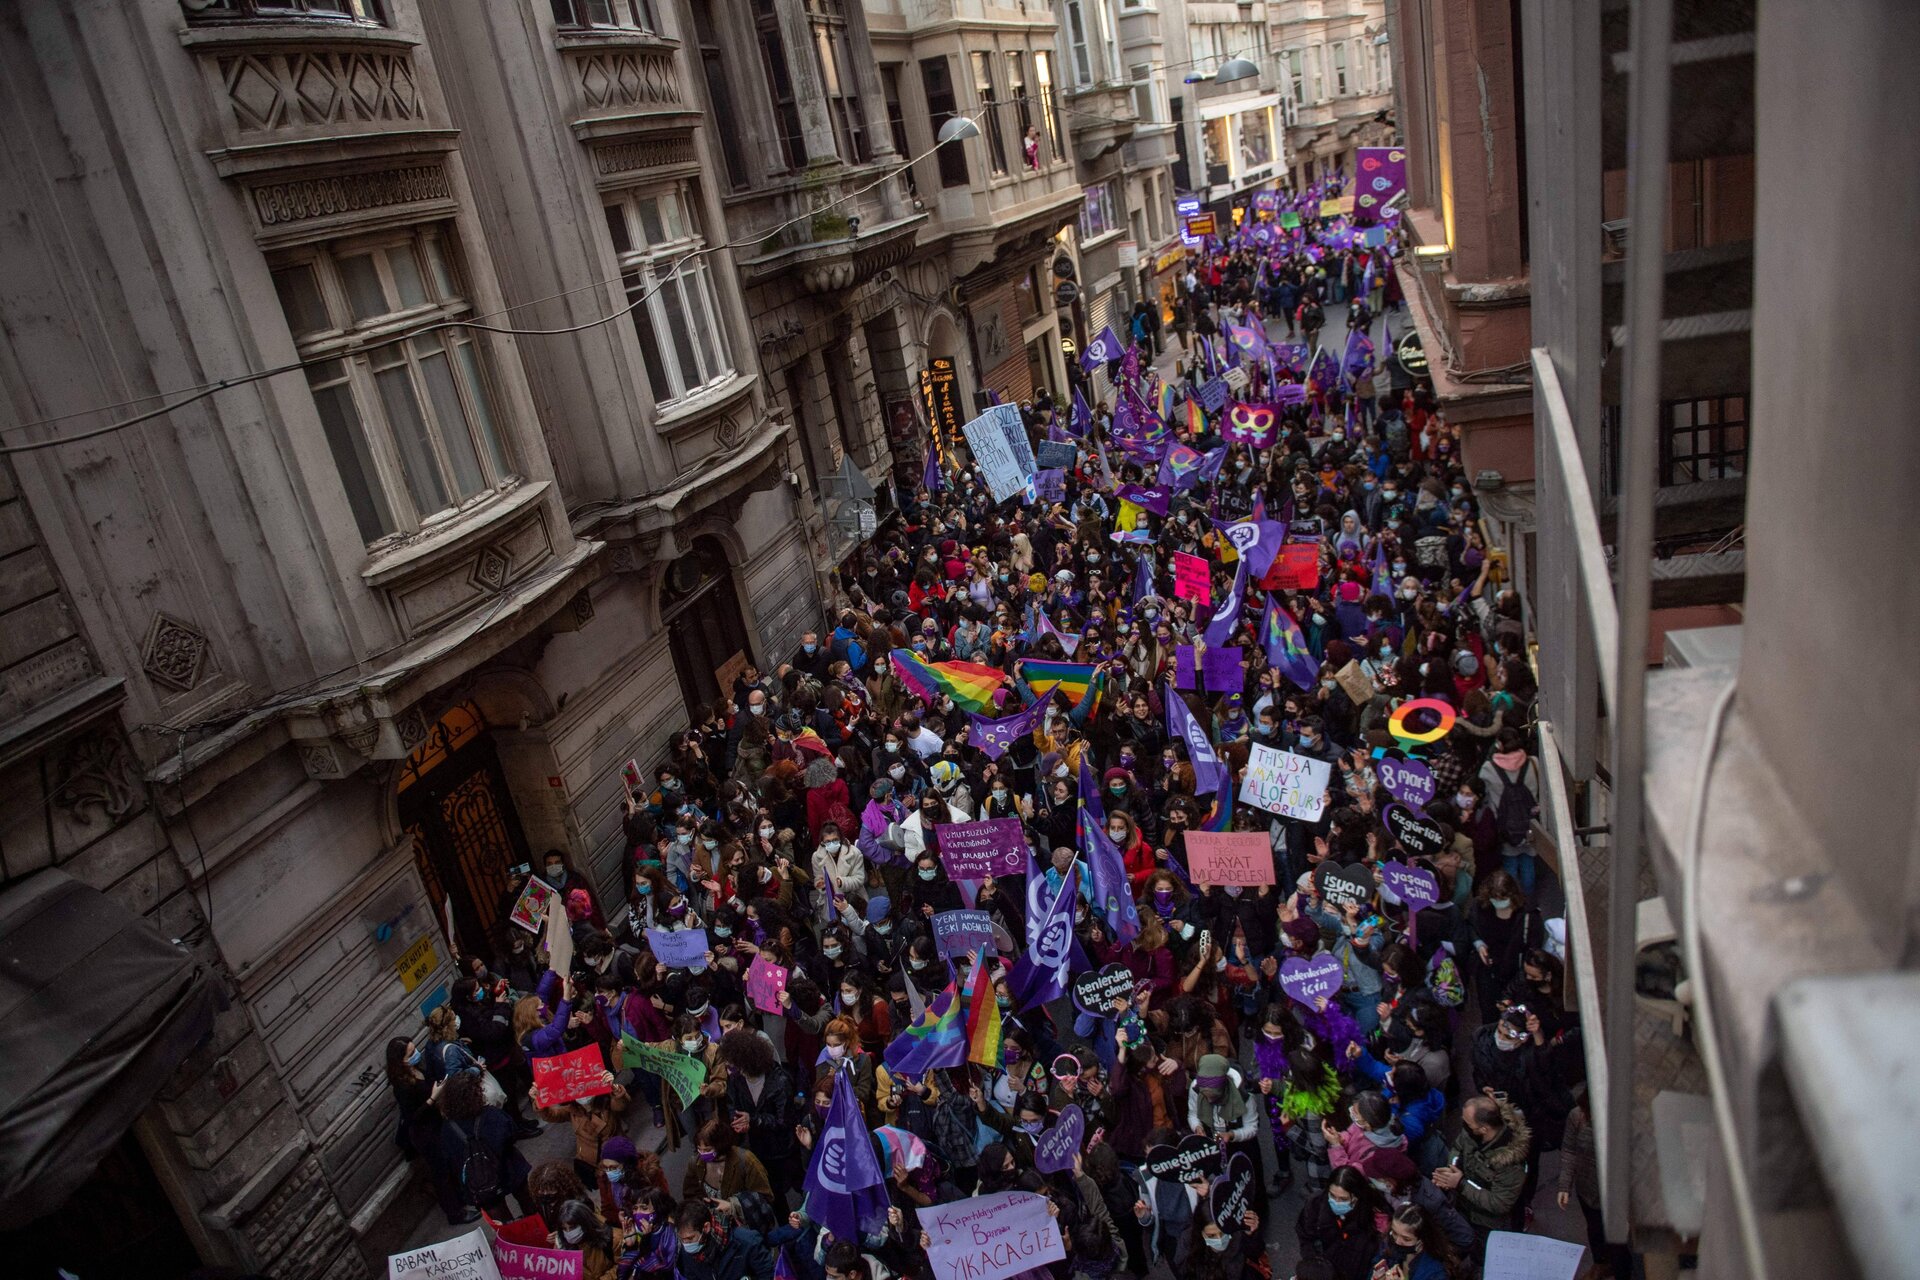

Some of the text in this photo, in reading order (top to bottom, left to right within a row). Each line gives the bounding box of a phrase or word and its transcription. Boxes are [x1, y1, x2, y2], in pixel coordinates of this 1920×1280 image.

[1301, 759, 1311, 776] A
[1381, 764, 1397, 790] 8
[1259, 798, 1307, 818] WORLD
[1390, 809, 1443, 845] özgürlük
[1400, 830, 1424, 851] için
[1207, 856, 1251, 868] HAYAT
[1322, 872, 1366, 898] isyan
[1389, 871, 1433, 890] yaşam
[1076, 969, 1132, 996] benlerden
[1280, 962, 1340, 985] bedenlerimiz
[1083, 980, 1134, 1006] biz olmak
[1300, 980, 1329, 997] için
[1041, 1113, 1077, 1158] devrim
[1051, 1135, 1073, 1161] için
[1151, 1143, 1220, 1174] emeğimiz
[1217, 1170, 1252, 1227] mücadele
[523, 1253, 576, 1276] KADIN
[946, 1227, 1057, 1280] YIKACAĞIZ
